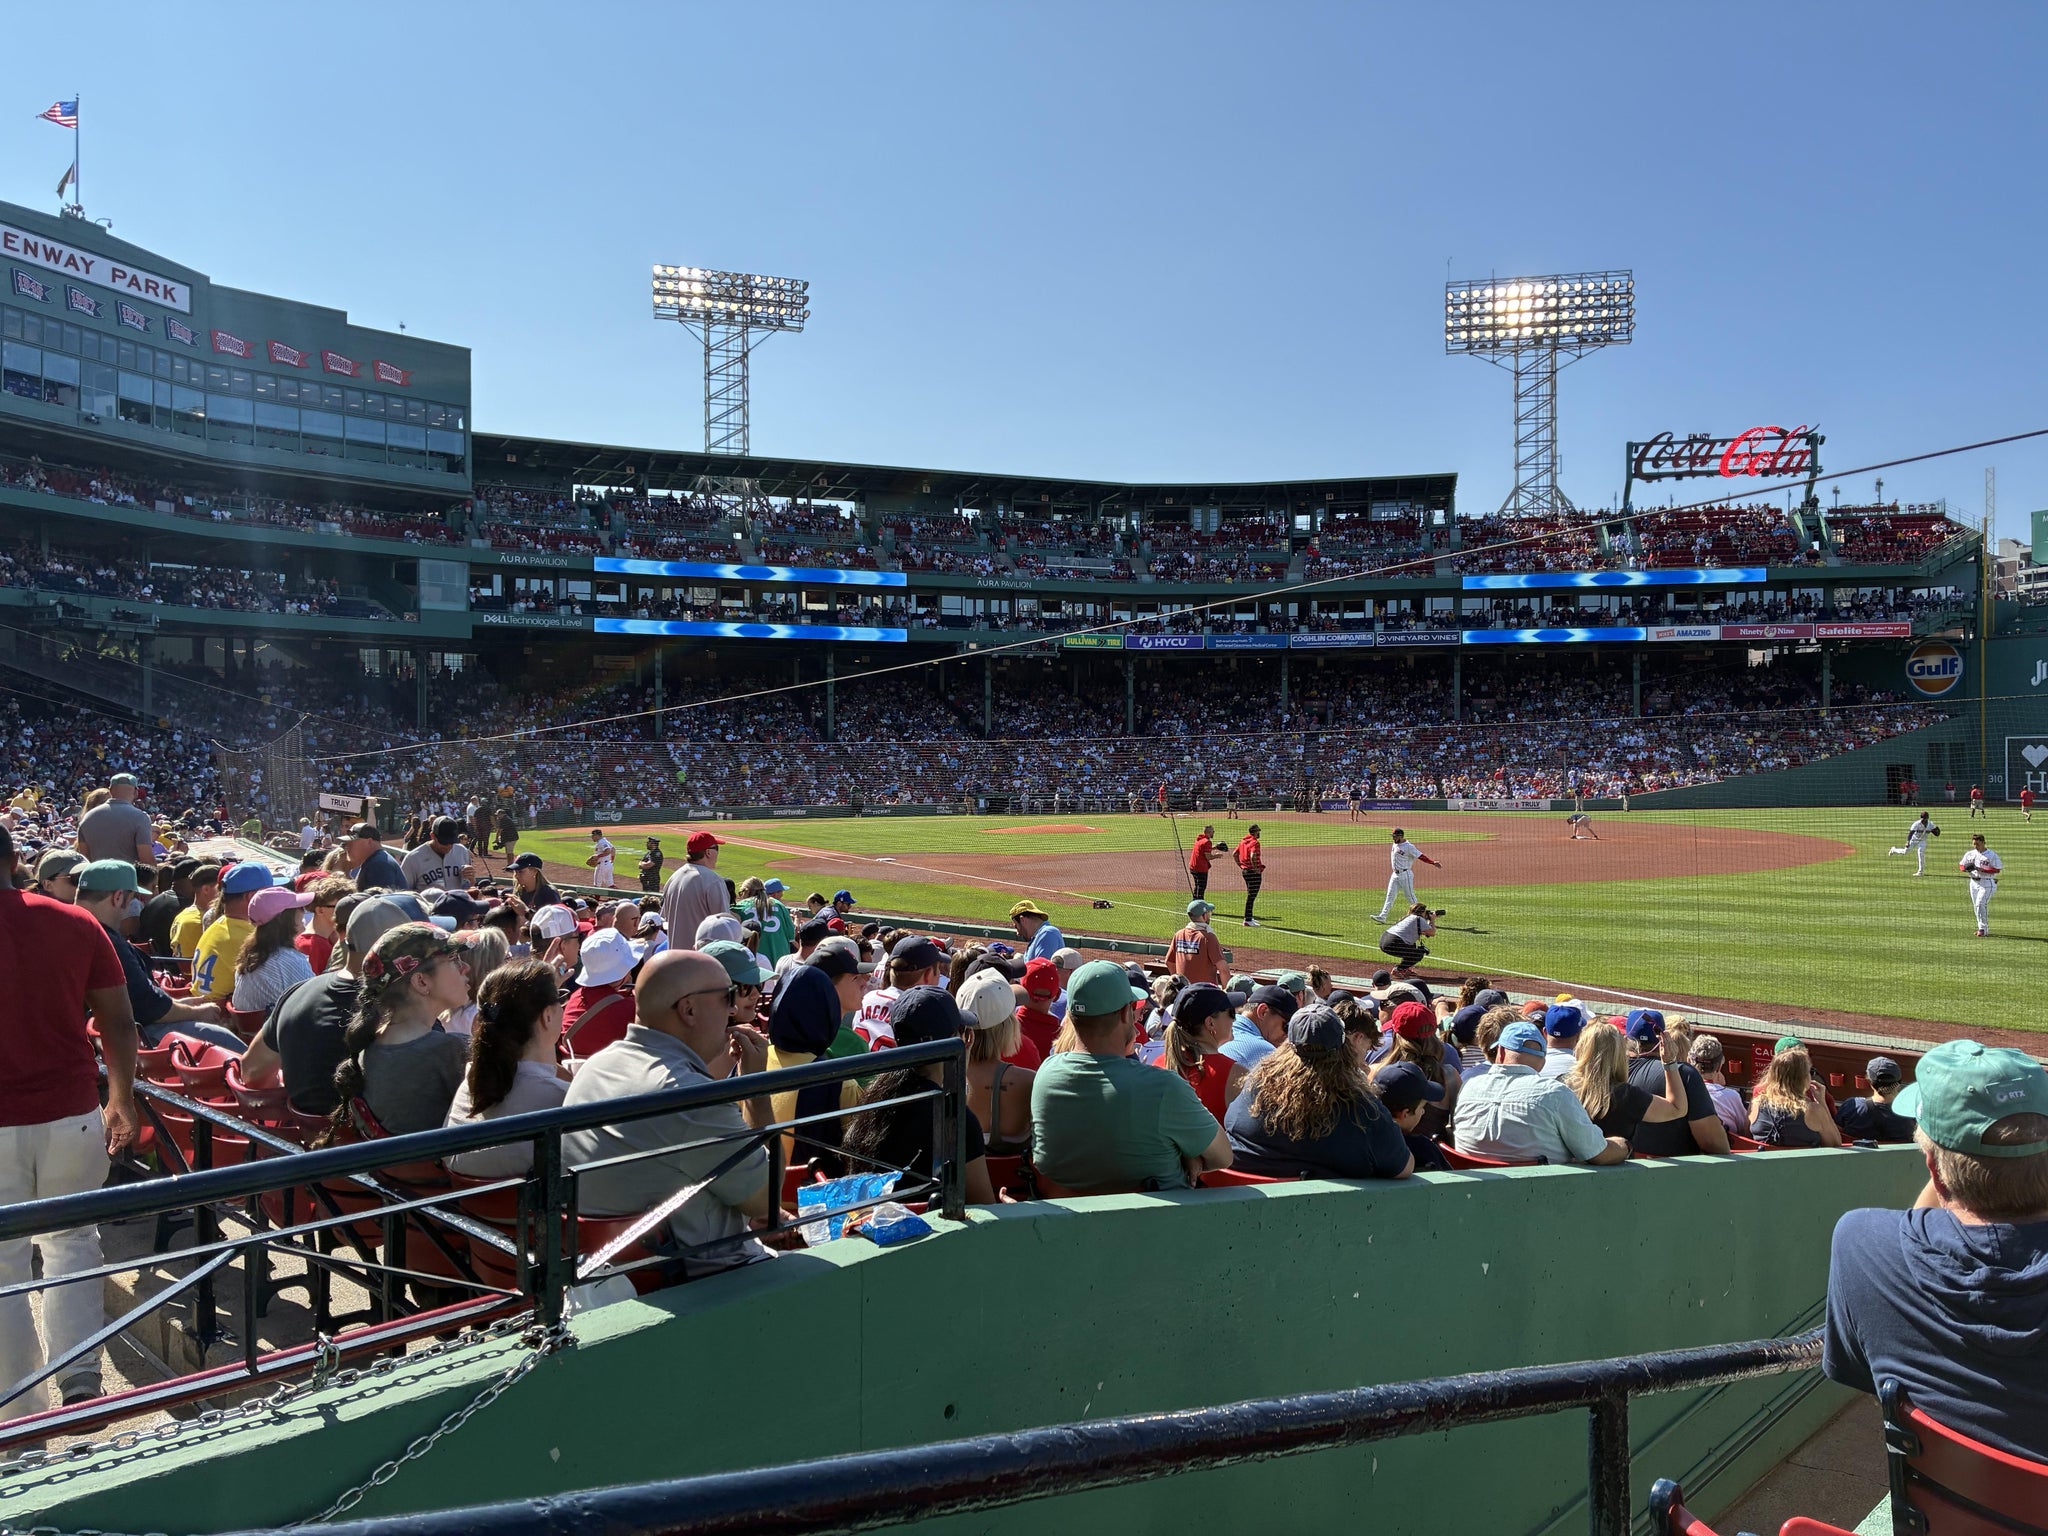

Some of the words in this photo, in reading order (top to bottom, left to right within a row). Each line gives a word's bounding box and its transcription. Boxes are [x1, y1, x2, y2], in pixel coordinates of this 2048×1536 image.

[111, 267, 177, 303] PARK
[529, 556, 568, 567] PAVILION
[1001, 580, 1032, 589] PAVILION
[483, 614, 509, 623] DELL
[509, 615, 560, 627] Technologies
[561, 618, 582, 627] Level
[1676, 629, 1711, 637] AMAZING
[1739, 628, 1764, 636] Ninety
[1777, 626, 1795, 635] Nine
[1818, 627, 1862, 635] Safelite
[1066, 637, 1097, 645] SULLIVAN
[1154, 638, 1187, 647] HYCU
[1326, 634, 1373, 642] COMPANIES
[1386, 634, 1430, 642] VINEYARD
[1908, 657, 1960, 676] Gulf
[1988, 774, 2003, 783] 310
[2025, 771, 2048, 794] H
[331, 798, 350, 807] TRULY
[1330, 802, 1349, 810] xfinit
[773, 808, 807, 816] smartwater
[422, 866, 460, 885] BOSTO
[2009, 1090, 2026, 1099] RTX
